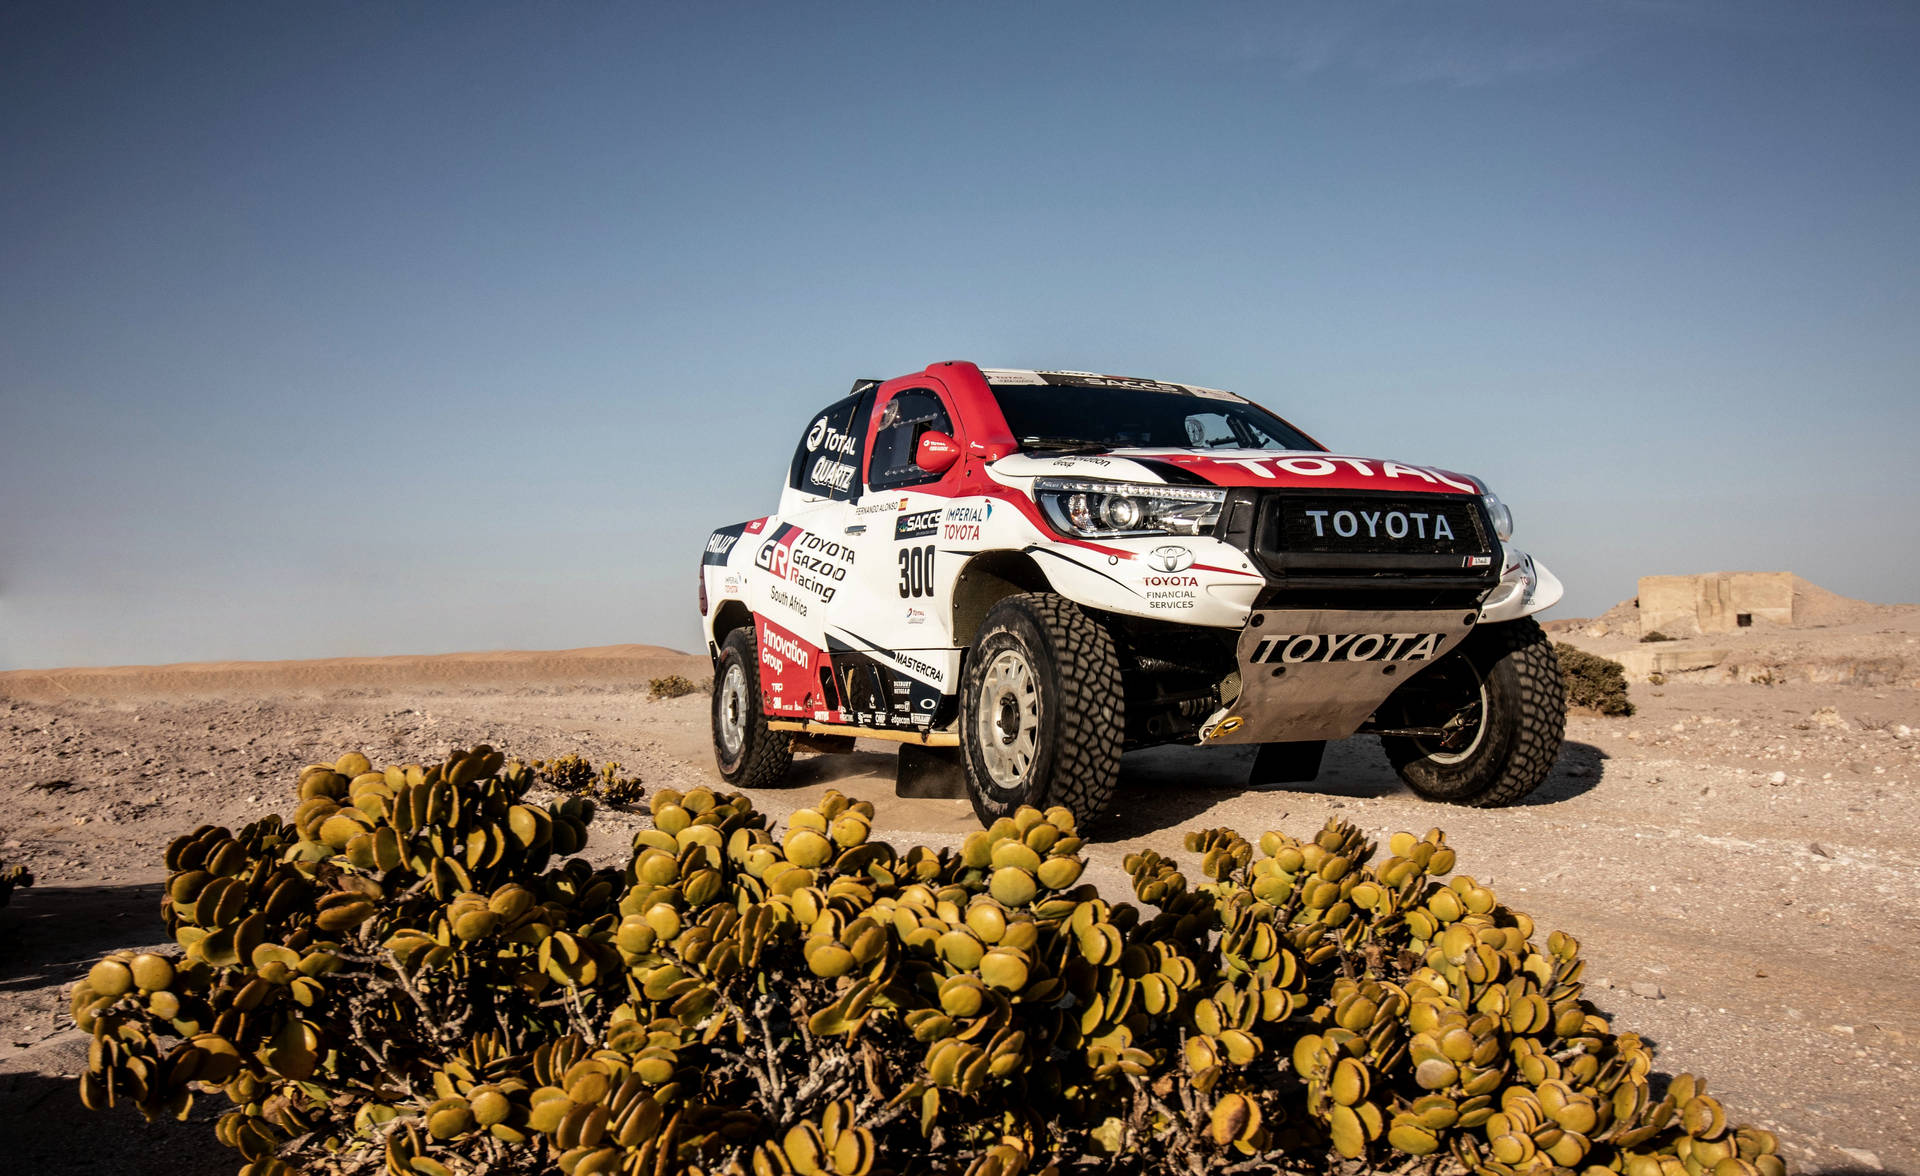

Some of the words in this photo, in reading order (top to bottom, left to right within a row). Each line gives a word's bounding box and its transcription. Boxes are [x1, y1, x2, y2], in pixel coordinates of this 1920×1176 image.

[1084, 377, 1178, 393] SACCS
[824, 427, 856, 456] TOTAL
[811, 456, 857, 492] QUARTZ
[1213, 457, 1475, 494] TOTAL
[856, 503, 880, 515] FERNANDO
[880, 501, 898, 512] ALONSO
[946, 508, 982, 522] IMPERIAL
[944, 525, 980, 540] TOYOTA
[1306, 510, 1455, 540] TOYOTA
[800, 532, 855, 564] TOYOTA
[792, 549, 846, 582] GAZOO
[899, 545, 935, 598] 300
[790, 567, 836, 603] Racing
[1143, 577, 1198, 586] TOYOTA
[1146, 591, 1196, 599] FINANCIAL
[771, 585, 788, 606] South
[789, 595, 808, 616] Africa
[1149, 601, 1194, 609] SERVICES
[763, 622, 808, 670] Innovation
[1257, 634, 1437, 664] TOYOTA
[762, 647, 783, 676] Group
